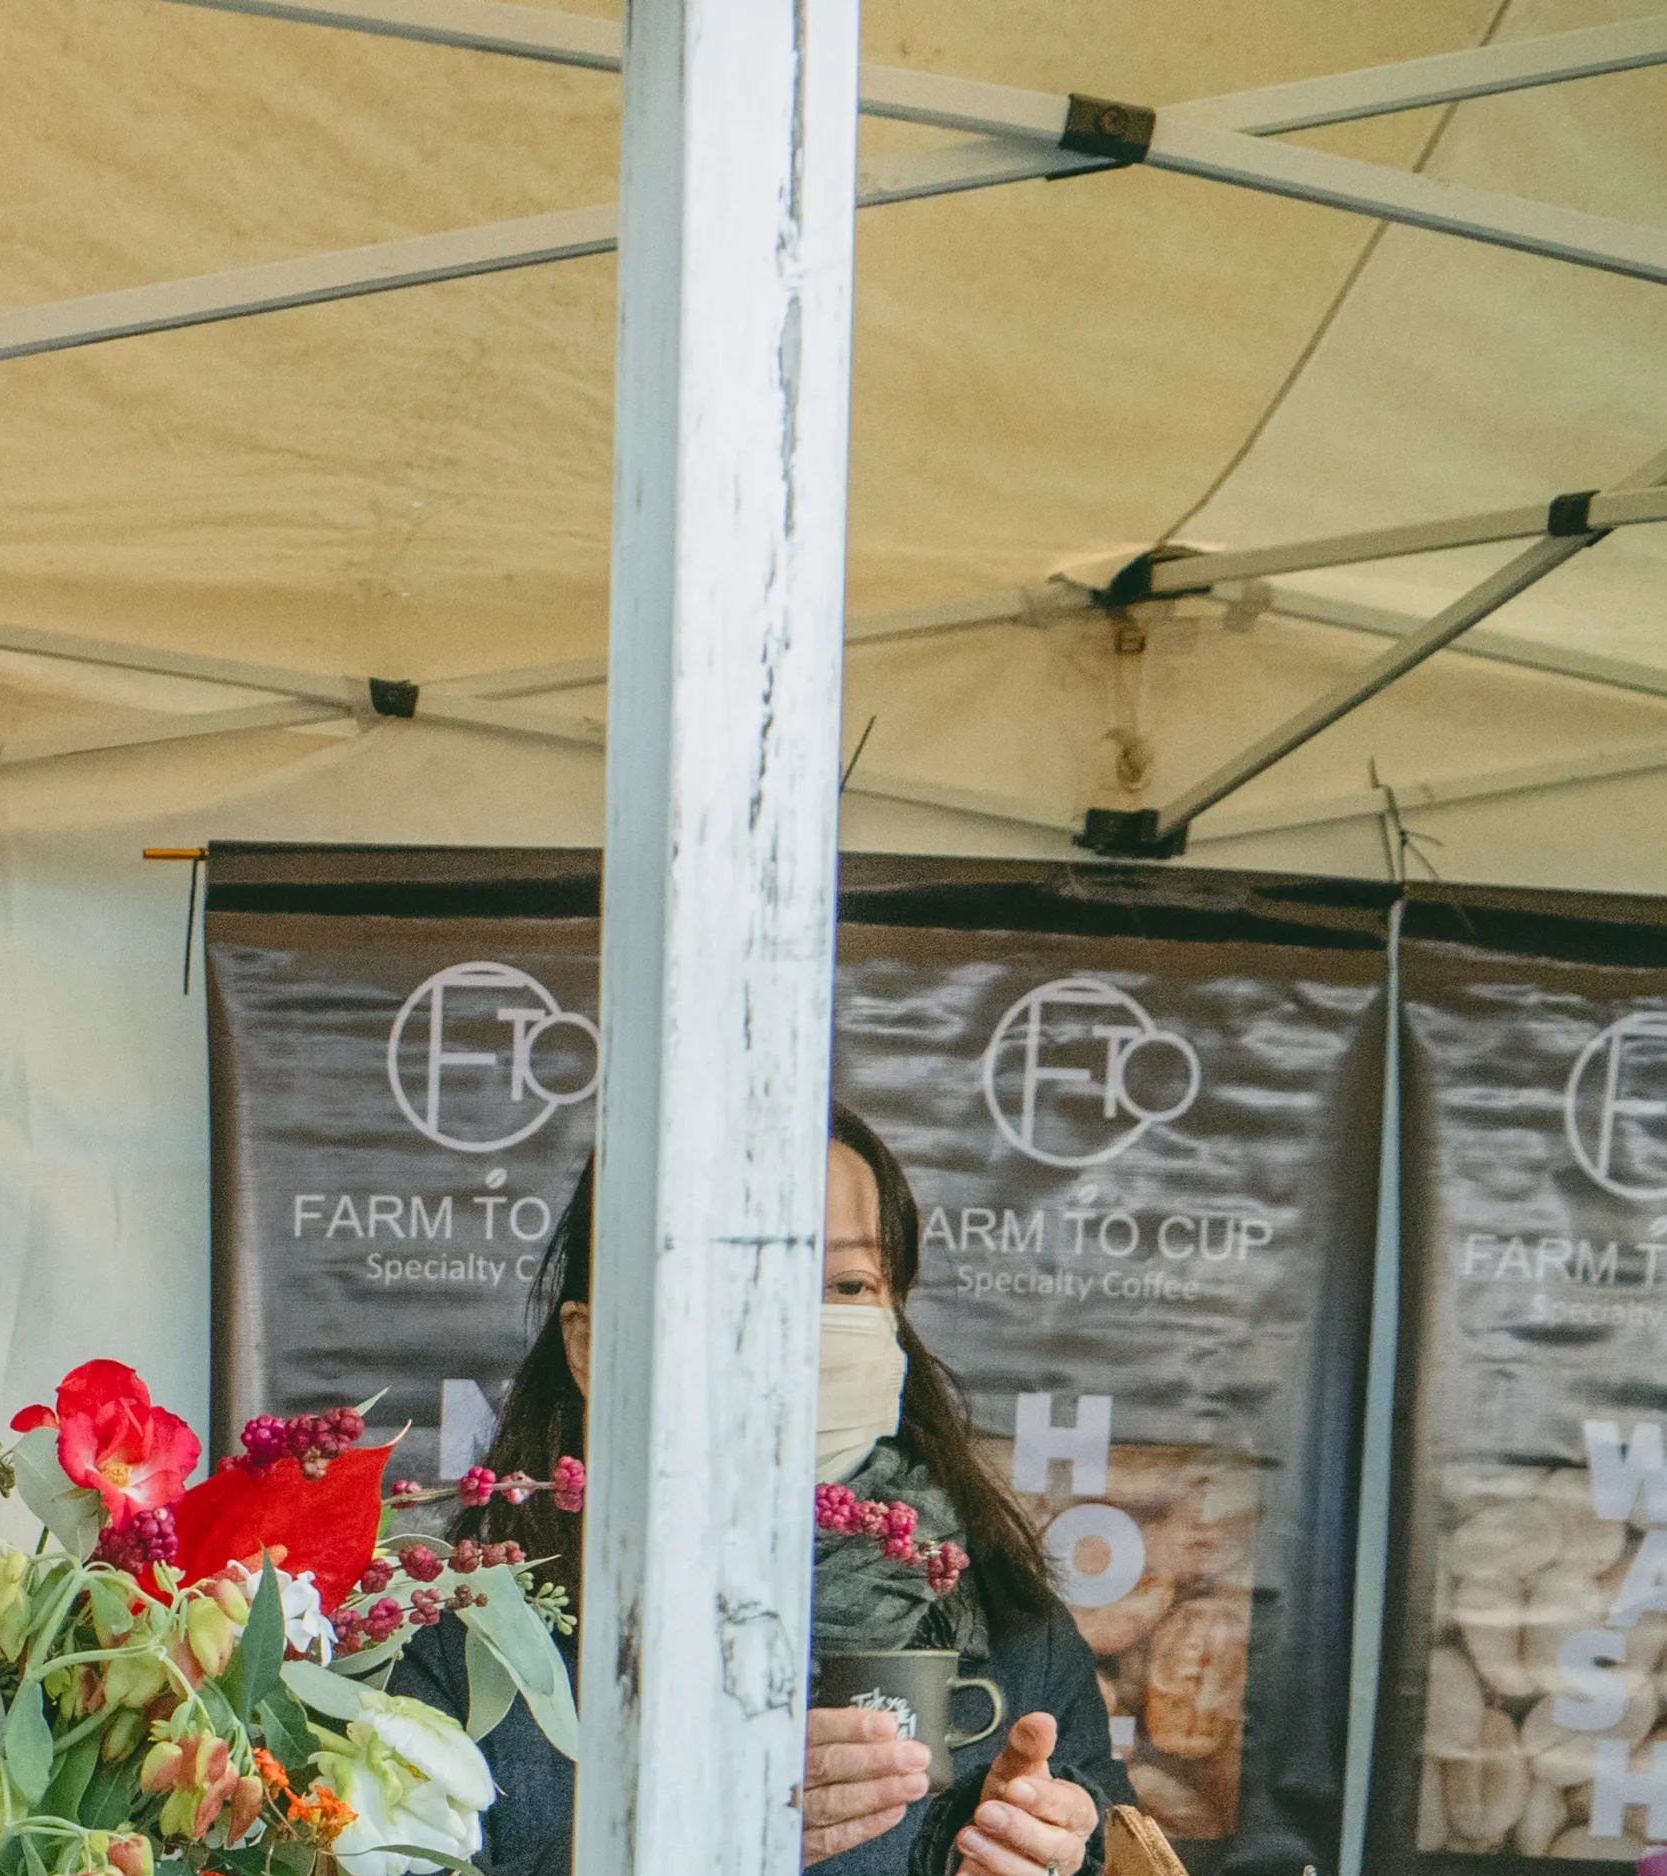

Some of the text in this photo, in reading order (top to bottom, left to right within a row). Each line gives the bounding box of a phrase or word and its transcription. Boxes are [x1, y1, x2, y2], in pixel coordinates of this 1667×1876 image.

[293, 1194, 551, 1241] FARM TO
[921, 1206, 1273, 1262] ARM TO CUP
[366, 1252, 505, 1287] Specialty
[1464, 1233, 1619, 1286] FARM
[956, 1265, 1200, 1303] Specialty Coffee
